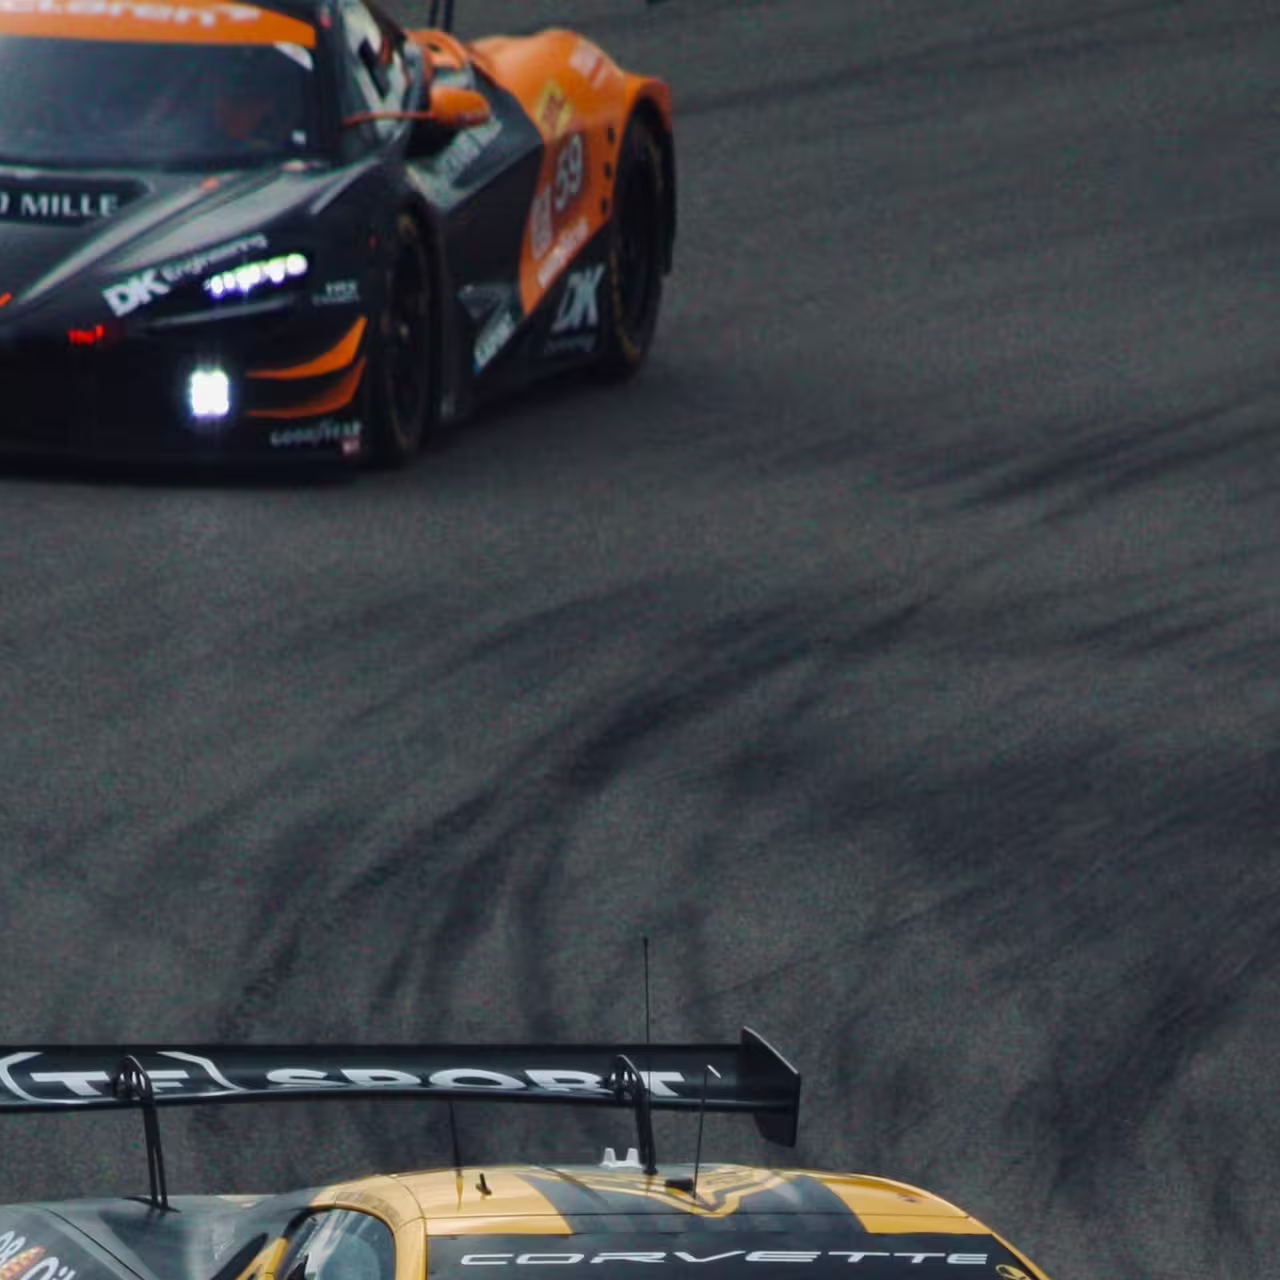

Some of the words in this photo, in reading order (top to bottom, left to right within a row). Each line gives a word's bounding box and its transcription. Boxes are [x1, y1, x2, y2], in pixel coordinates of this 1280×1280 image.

[20, 194, 118, 218] MILLE
[101, 268, 170, 317] DK
[551, 265, 606, 333] DK
[460, 1250, 989, 1267] CORVETTE
